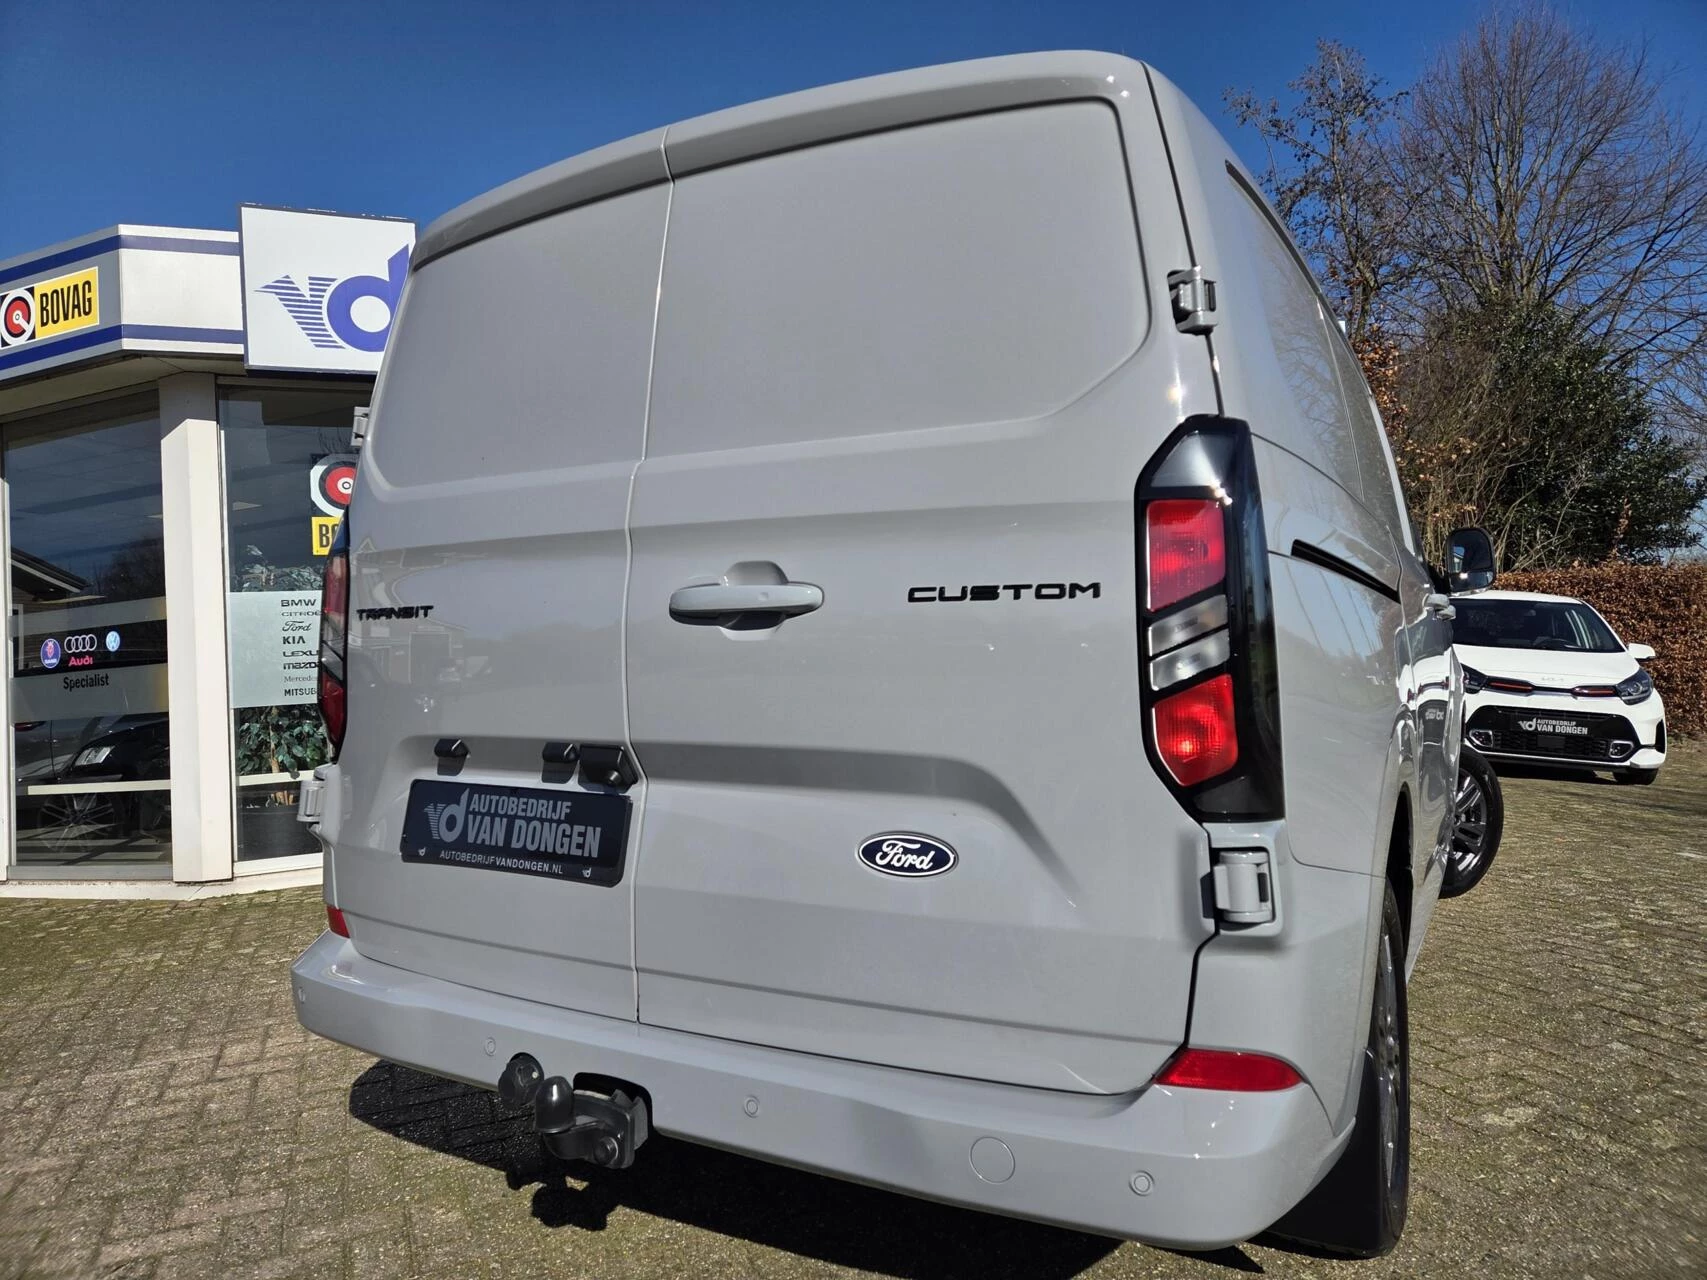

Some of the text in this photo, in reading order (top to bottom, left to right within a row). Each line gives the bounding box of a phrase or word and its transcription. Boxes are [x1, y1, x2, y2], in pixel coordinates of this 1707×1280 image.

[39, 279, 93, 328] BOVAG
[907, 582, 1102, 603] CUSTOM
[280, 598, 317, 607] BMW
[356, 604, 434, 621] TRANSIT
[281, 620, 313, 632] Ford
[282, 635, 306, 645] KIA
[68, 655, 94, 667] Audi
[63, 673, 110, 692] Specialist
[1537, 724, 1588, 735] VAN DONGEN
[469, 793, 572, 821] AUTOBEDRIJF
[467, 814, 602, 859] VAN DONGEN
[439, 849, 564, 875] AUTOBEDRIJFVANDONGEN.NL
[875, 839, 936, 870] Ford
